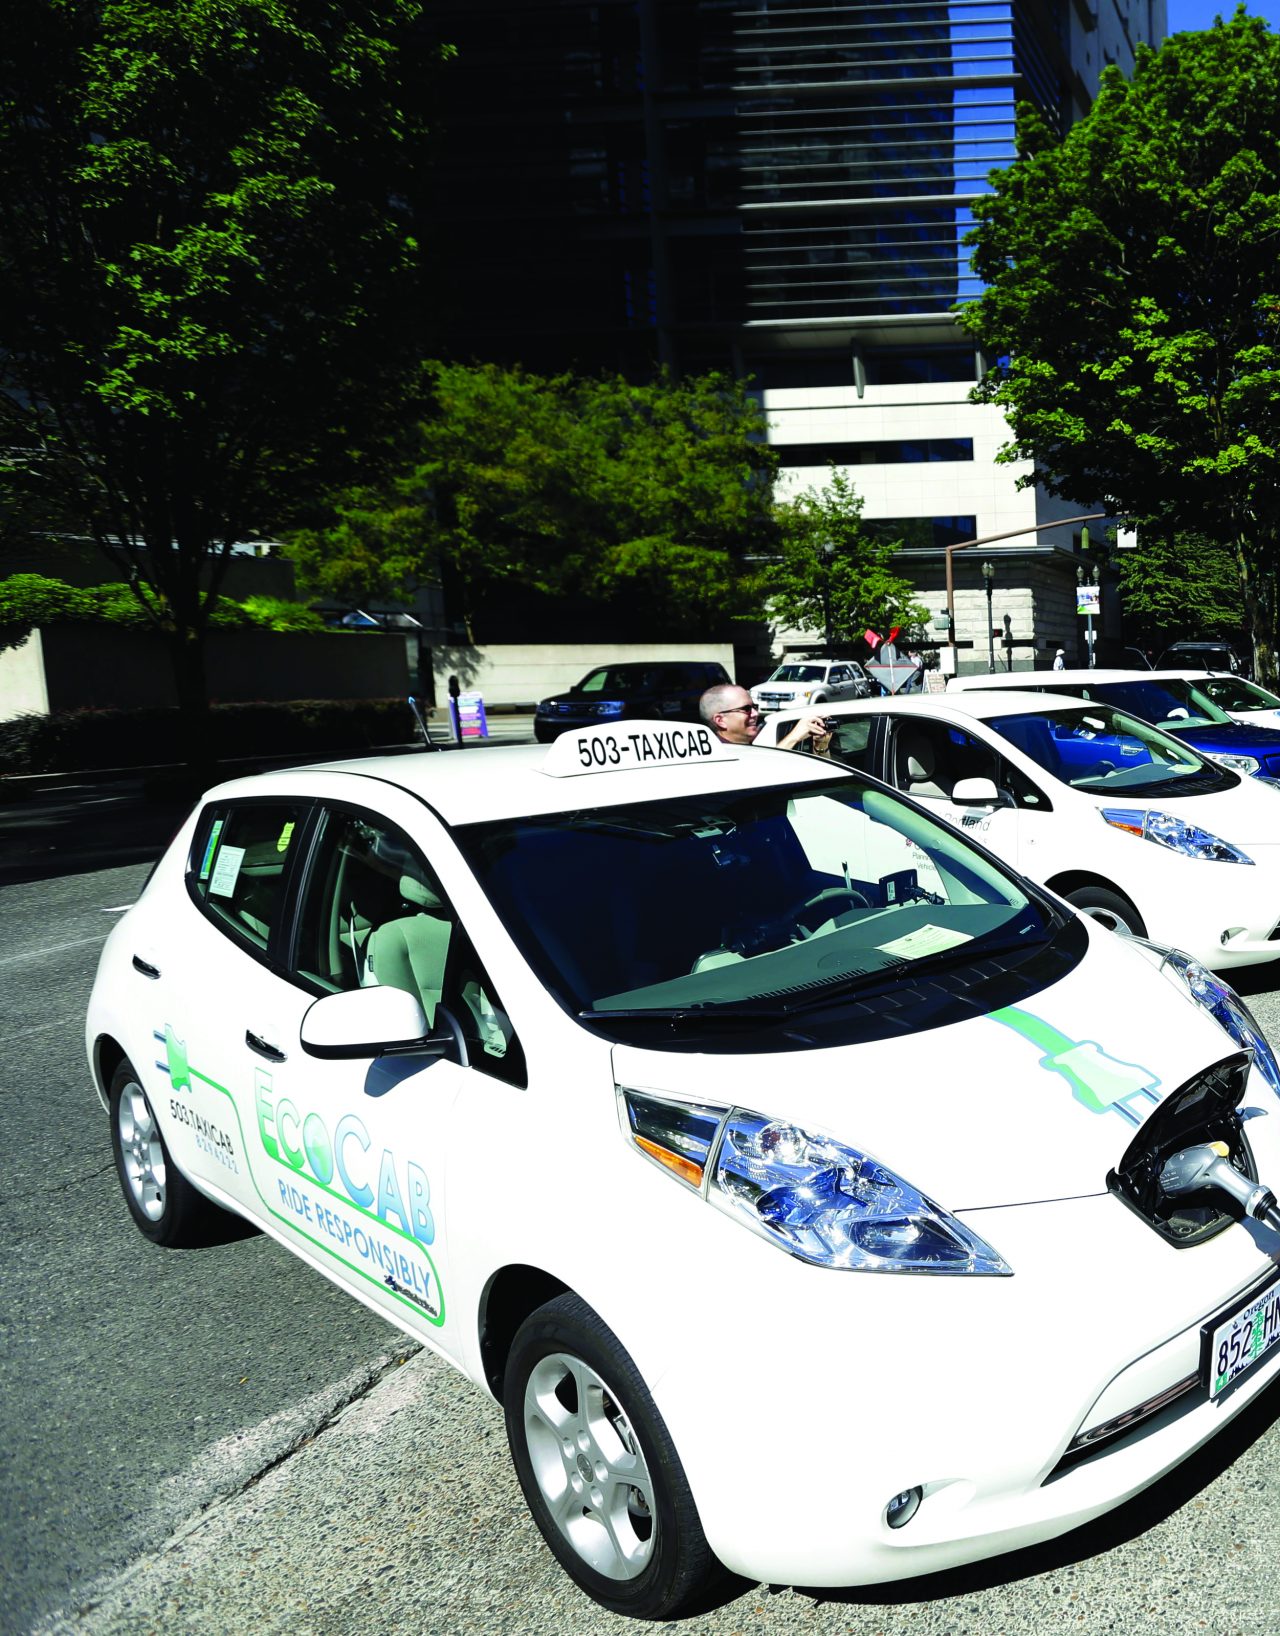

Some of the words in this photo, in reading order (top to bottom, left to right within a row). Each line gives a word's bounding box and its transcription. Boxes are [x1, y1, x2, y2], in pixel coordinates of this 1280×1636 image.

[577, 729, 712, 767] 503-TAXICAB
[278, 1178, 313, 1222] RIDE
[316, 1208, 430, 1299] RESPONSIBLY
[1243, 1289, 1275, 1320] Oregon
[1217, 1320, 1254, 1377] 852
